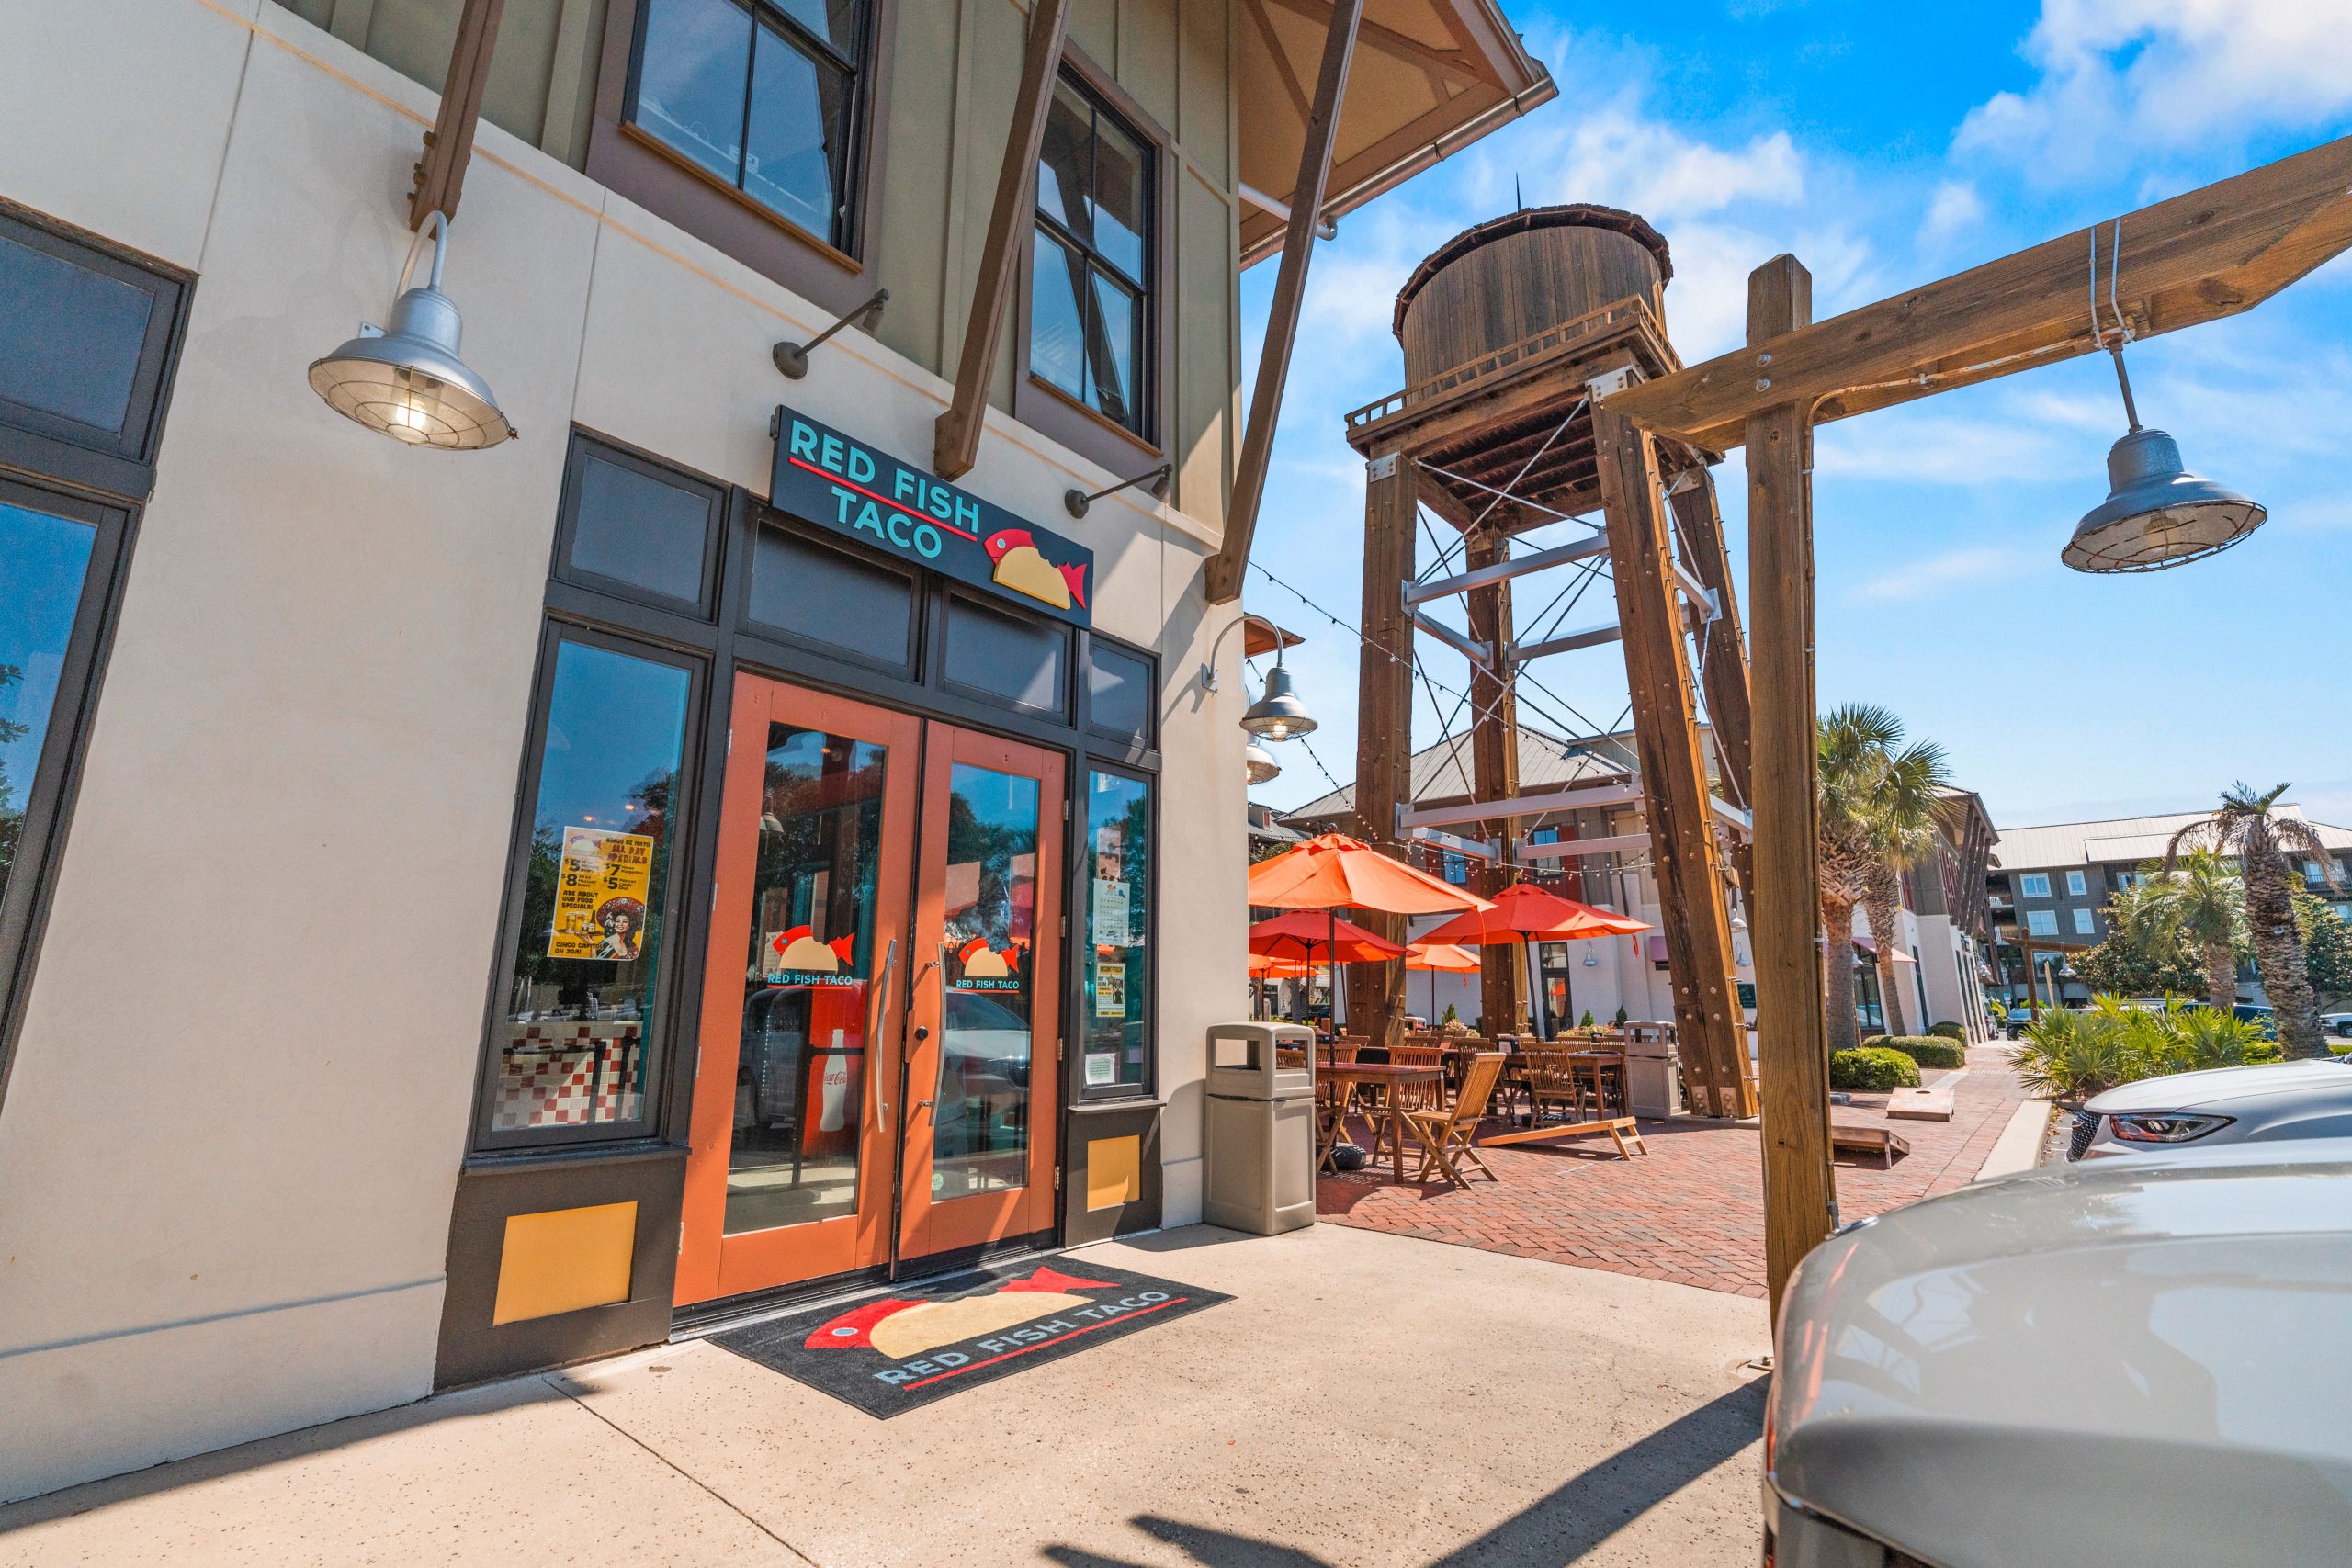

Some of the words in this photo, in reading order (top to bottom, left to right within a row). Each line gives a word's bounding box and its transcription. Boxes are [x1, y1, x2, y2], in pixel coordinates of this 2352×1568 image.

[789, 419, 876, 484] RED
[894, 468, 979, 534] FISH
[831, 486, 942, 558] TACO
[629, 846, 645, 856] DAY
[767, 973, 790, 984] RED
[794, 974, 820, 985] FISH
[824, 975, 853, 986] TACO
[956, 979, 973, 988] RED
[976, 980, 995, 989] FISH
[998, 980, 1020, 989] TACO
[871, 1352, 970, 1384] RED
[977, 1319, 1077, 1353] FISH
[1073, 1292, 1170, 1319] TACO
